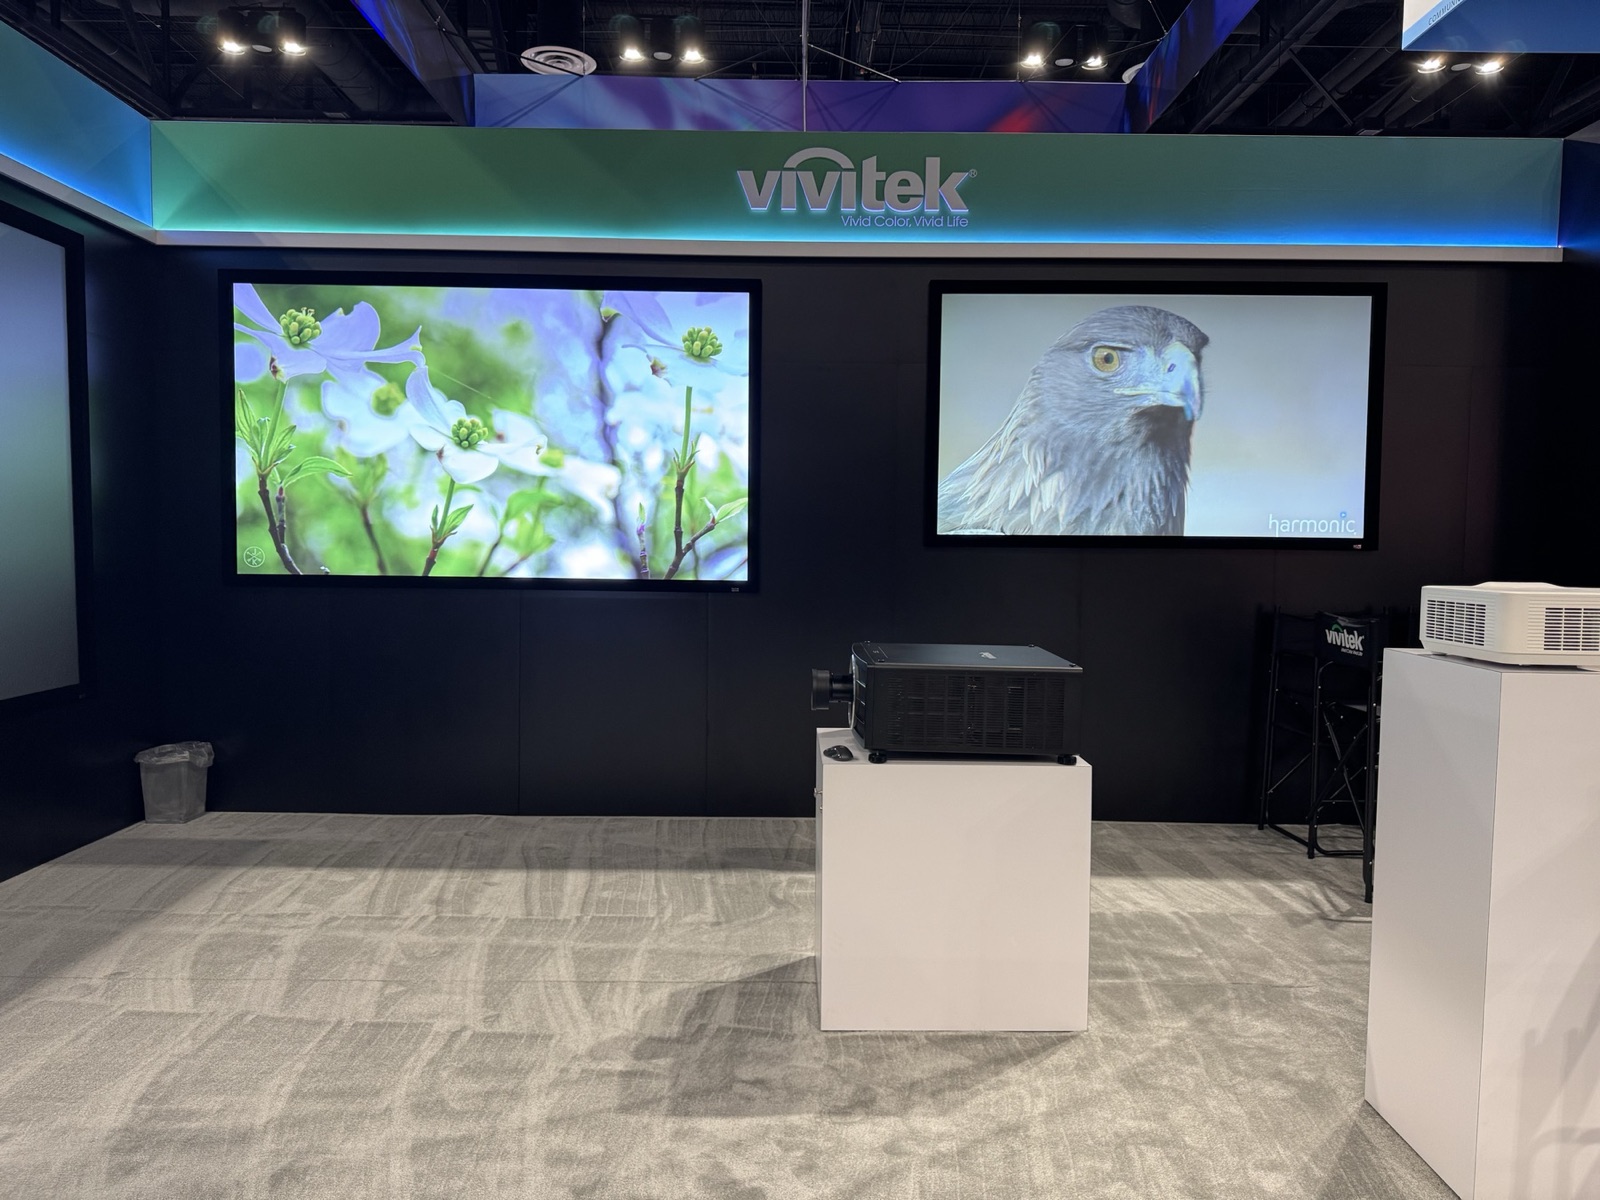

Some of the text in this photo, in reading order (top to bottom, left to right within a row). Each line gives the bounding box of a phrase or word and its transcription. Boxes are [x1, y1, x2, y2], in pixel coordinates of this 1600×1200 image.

[841, 215, 969, 228] Vivid Color, Vivid Life
[1268, 512, 1356, 537] harmonic
[1325, 624, 1364, 651] vivitek
